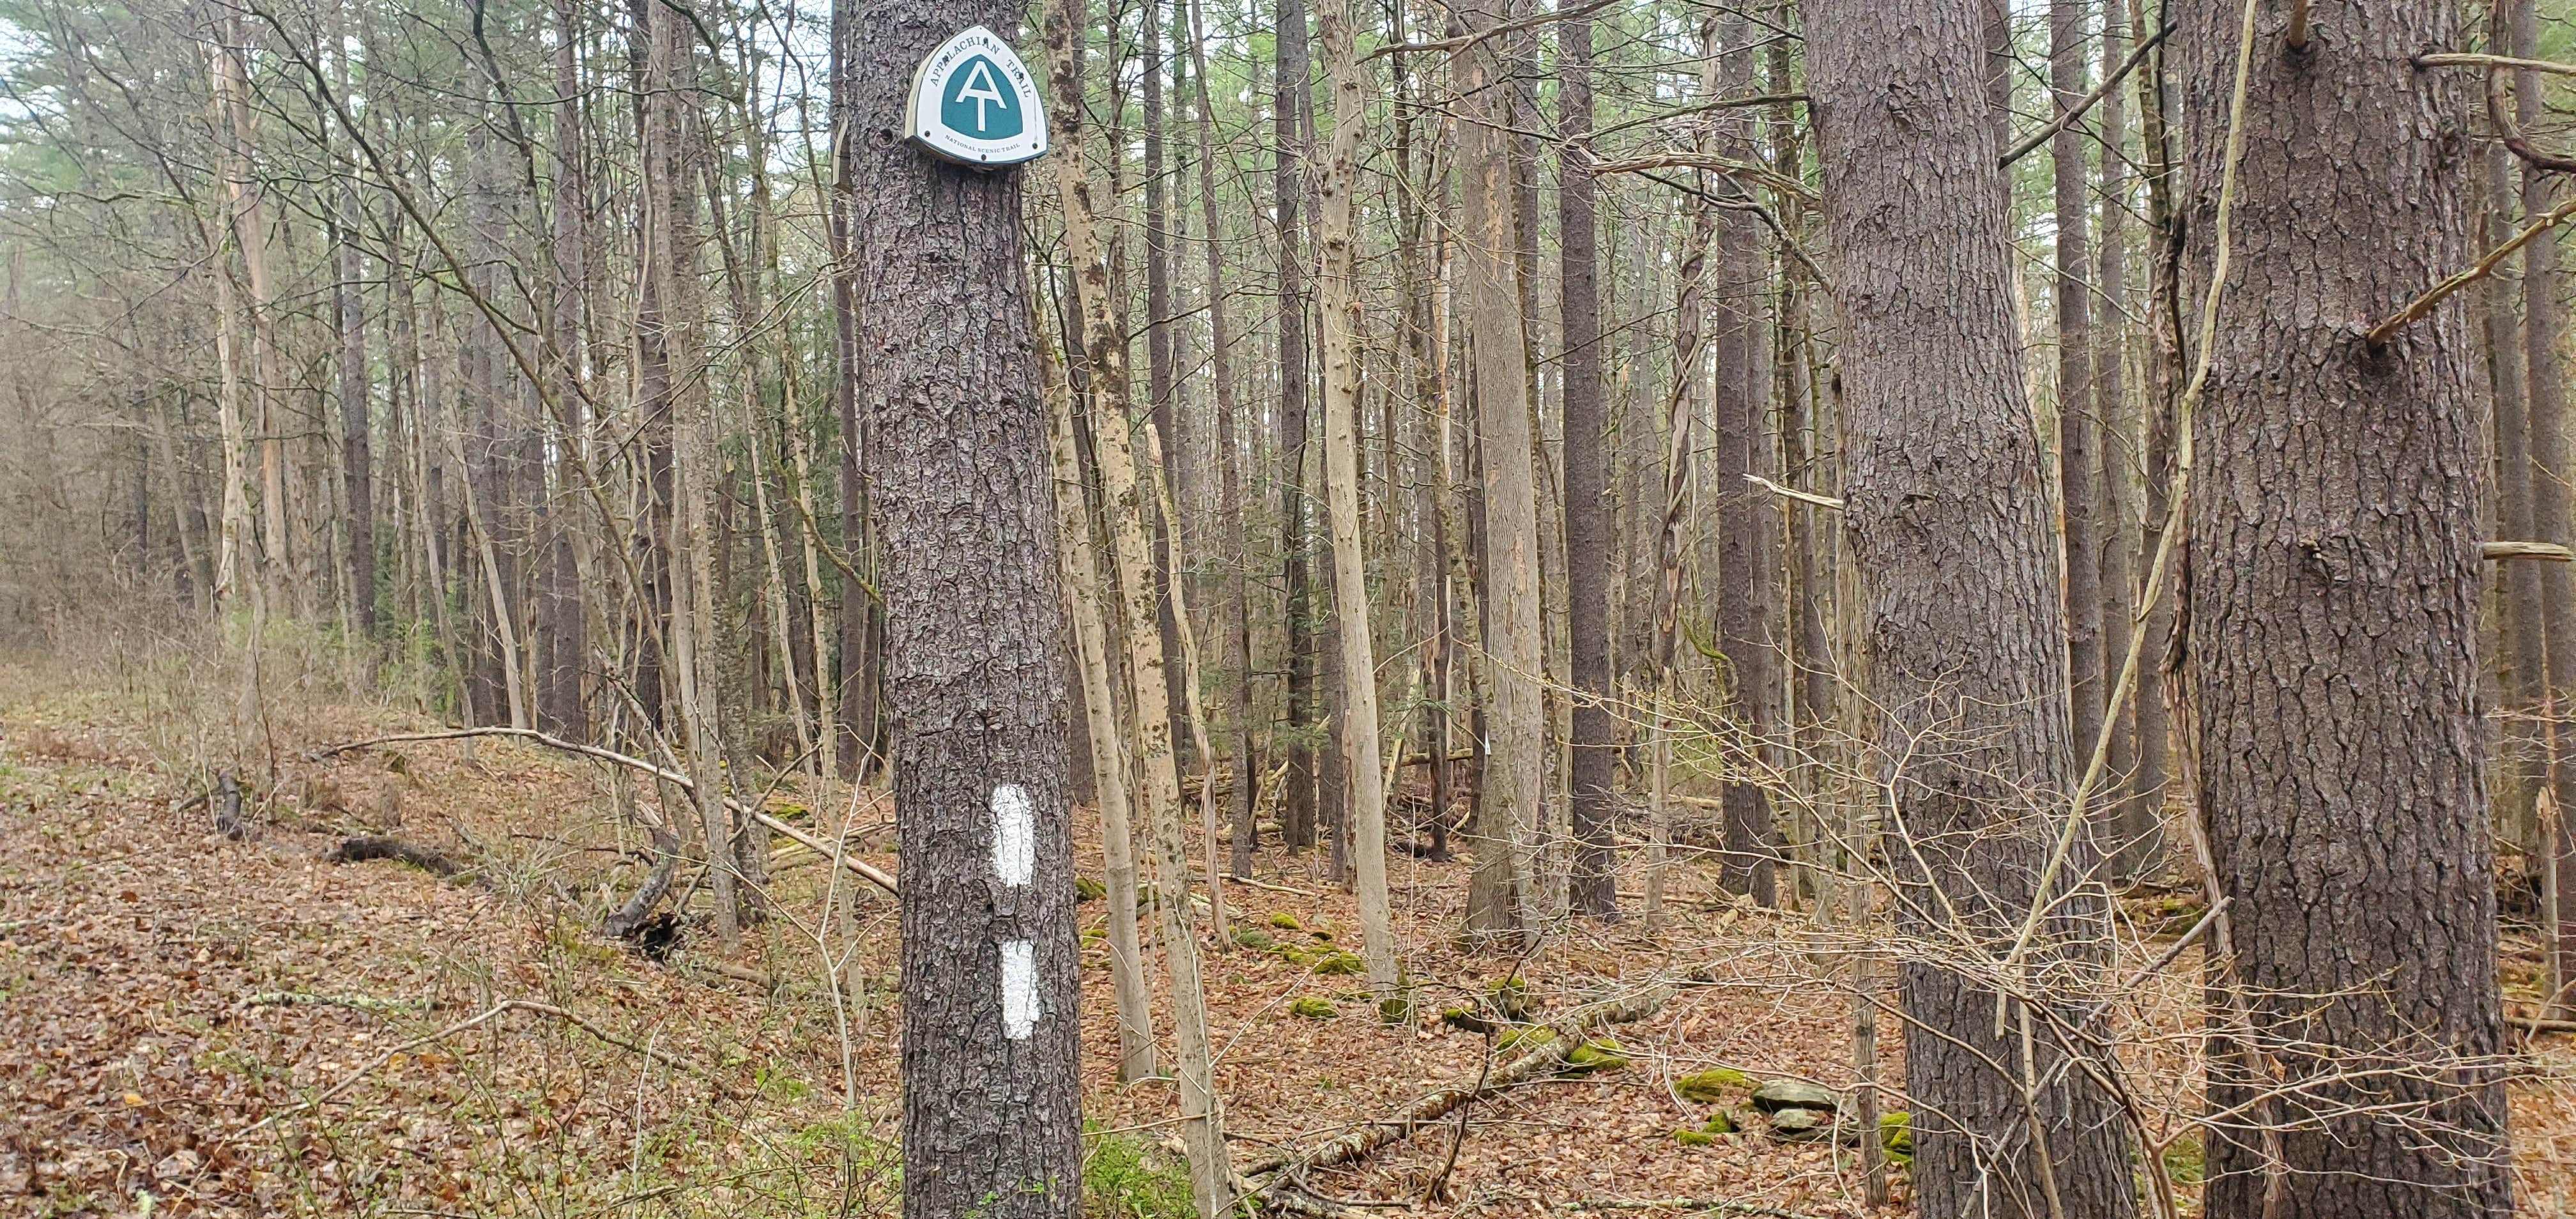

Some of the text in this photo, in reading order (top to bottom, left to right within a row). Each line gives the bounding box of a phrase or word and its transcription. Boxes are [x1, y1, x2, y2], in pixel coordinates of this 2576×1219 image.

[955, 61, 1008, 132] AT
[1006, 59, 1031, 98] TRAIL
[945, 135, 976, 151] NATIONAL
[1001, 143, 1020, 152] TRAIL
